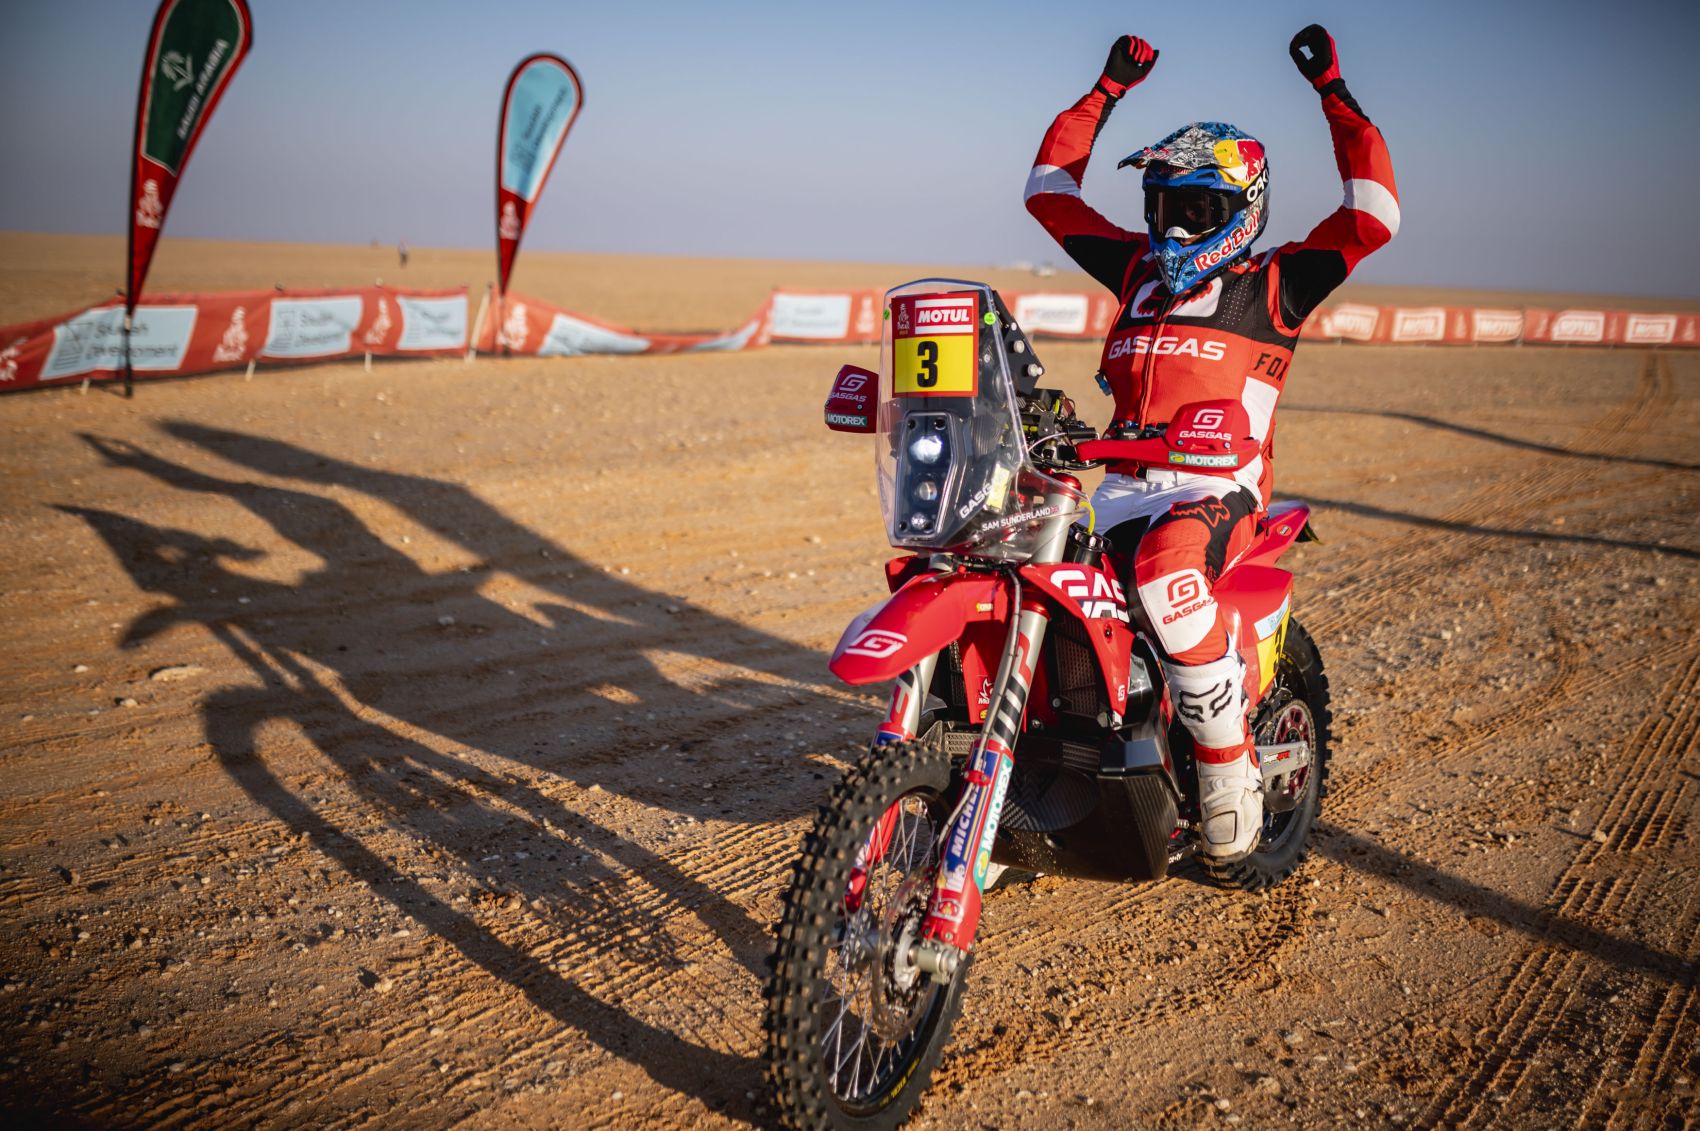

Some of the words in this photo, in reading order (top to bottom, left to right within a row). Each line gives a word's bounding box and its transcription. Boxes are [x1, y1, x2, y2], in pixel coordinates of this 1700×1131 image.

[1194, 236, 1234, 272] Red
[1231, 208, 1260, 248] Bull
[918, 308, 970, 324] MOTUL
[1107, 335, 1227, 361] GASGAS
[916, 341, 938, 388] 3
[1252, 351, 1288, 382] FOX
[827, 413, 865, 426] MOTOREX
[1179, 430, 1232, 441] GASGAS
[1185, 455, 1236, 467] MOTOREX
[981, 522, 1000, 532] SAM
[1000, 507, 1051, 527] SUNDERLAND
[980, 760, 1013, 851] MOTOREX
